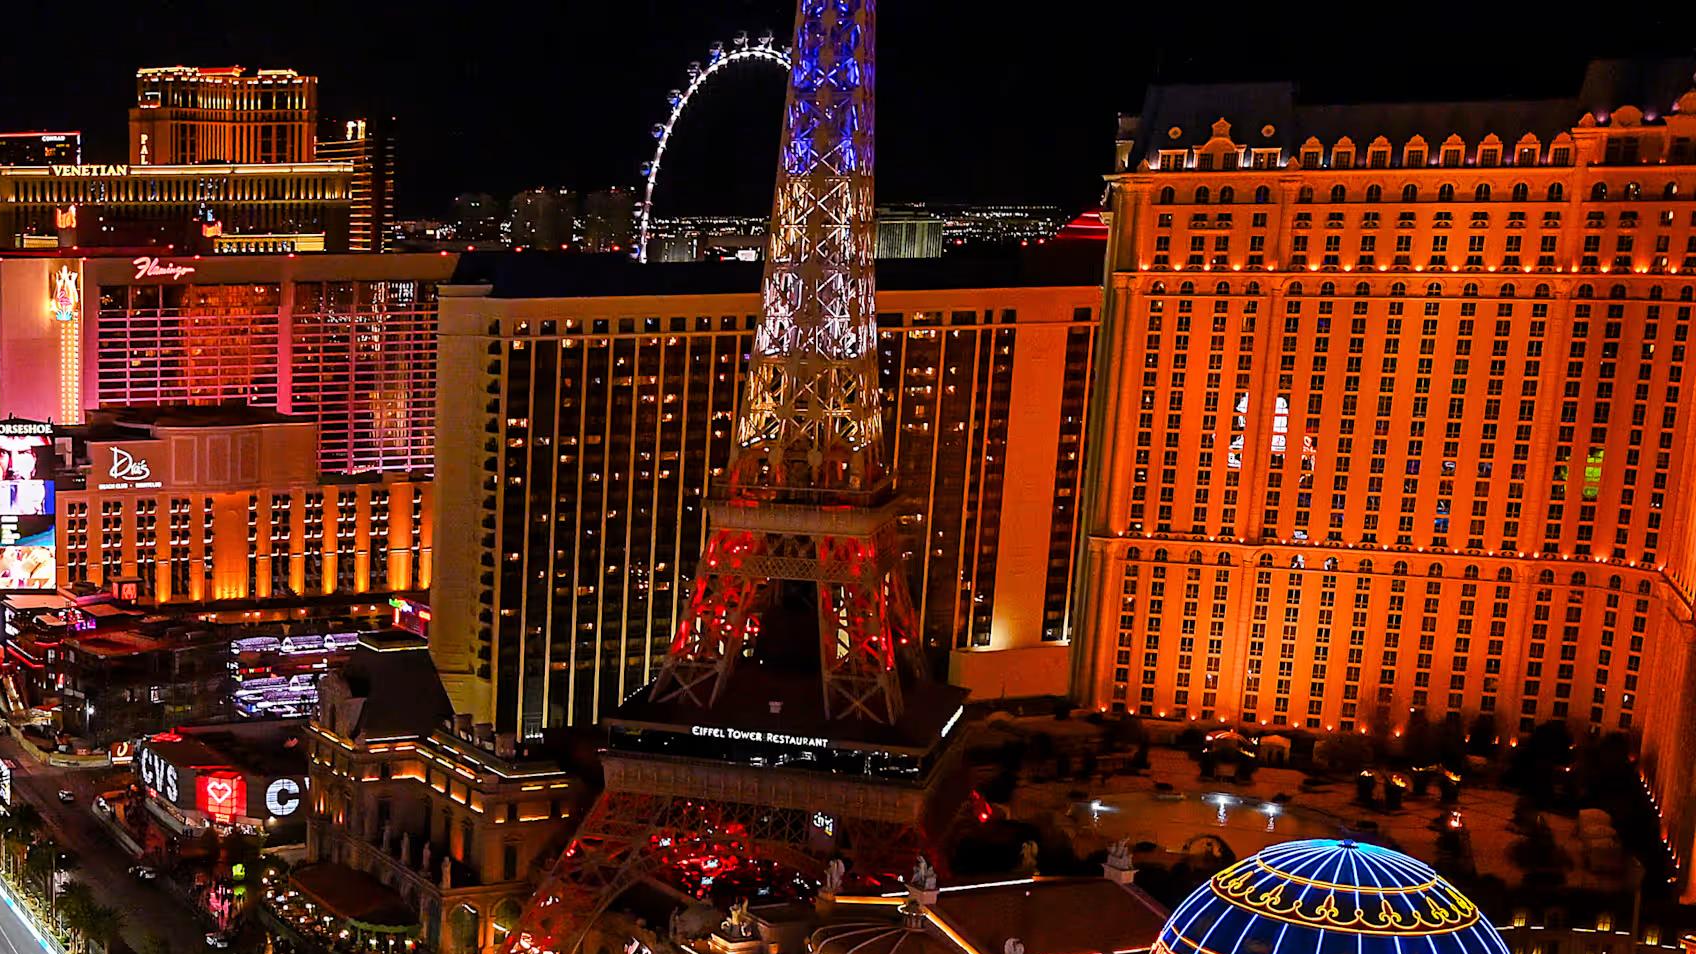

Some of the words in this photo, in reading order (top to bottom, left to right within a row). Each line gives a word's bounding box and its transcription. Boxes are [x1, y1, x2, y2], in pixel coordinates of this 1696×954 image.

[52, 165, 128, 177] VENETIAN
[133, 256, 196, 280] Flamingo
[691, 725, 725, 739] EIFFEL
[726, 727, 762, 742] TOWER
[766, 732, 829, 749] RESTAURANT
[141, 747, 179, 803] CVS
